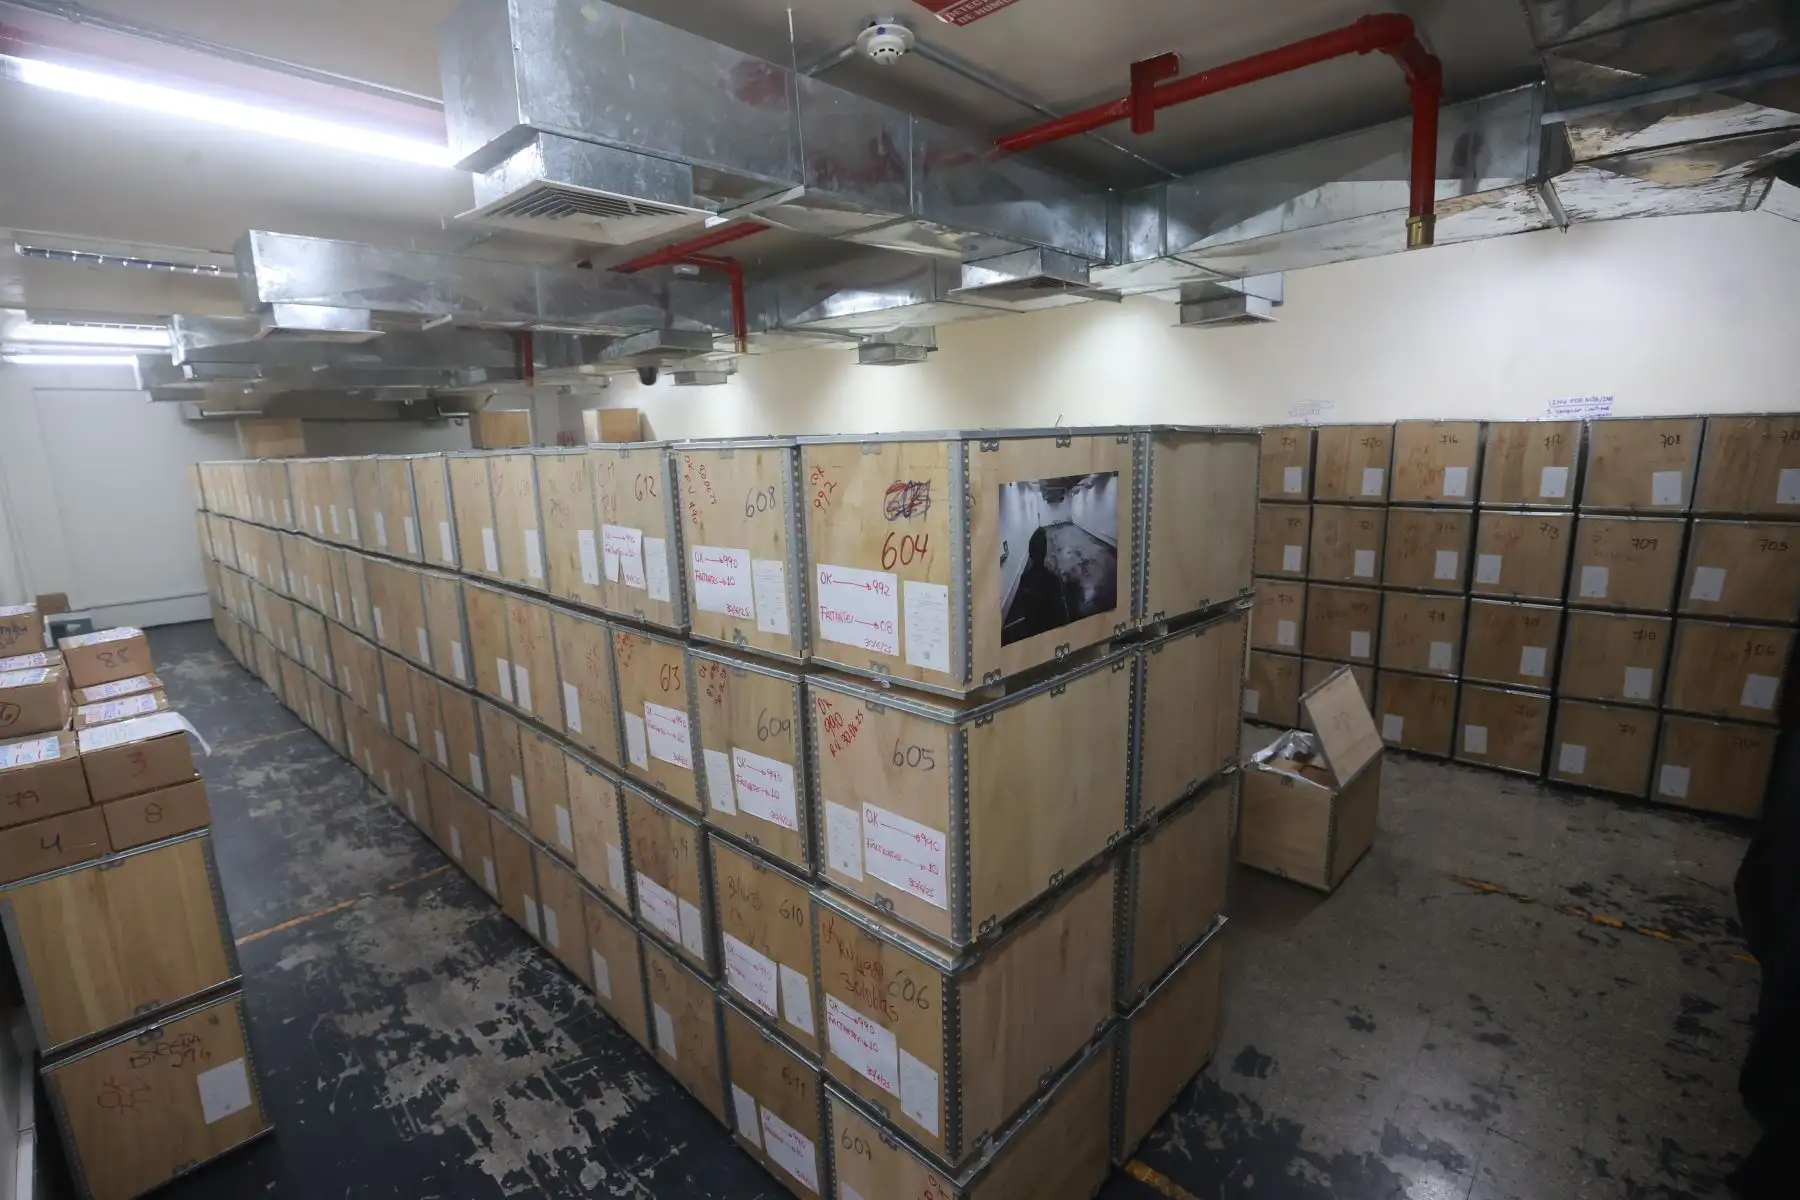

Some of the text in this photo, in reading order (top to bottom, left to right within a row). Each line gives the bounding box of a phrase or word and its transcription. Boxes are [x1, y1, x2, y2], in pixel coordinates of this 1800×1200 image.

[957, 13, 976, 23] DE
[745, 486, 776, 518] 608
[881, 532, 929, 571] 604
[1631, 538, 1658, 554] 709
[1759, 538, 1789, 552] 705
[820, 571, 890, 597] OK 992
[880, 620, 893, 635] 08
[659, 663, 682, 692] 613
[817, 697, 833, 715] OK
[757, 707, 792, 746] 609
[892, 738, 935, 772] 605
[5, 789, 40, 809] 79
[145, 803, 163, 825] 8
[866, 808, 879, 828] OK
[40, 833, 63, 854] 4
[778, 899, 804, 928] 610
[887, 970, 930, 1010] 606
